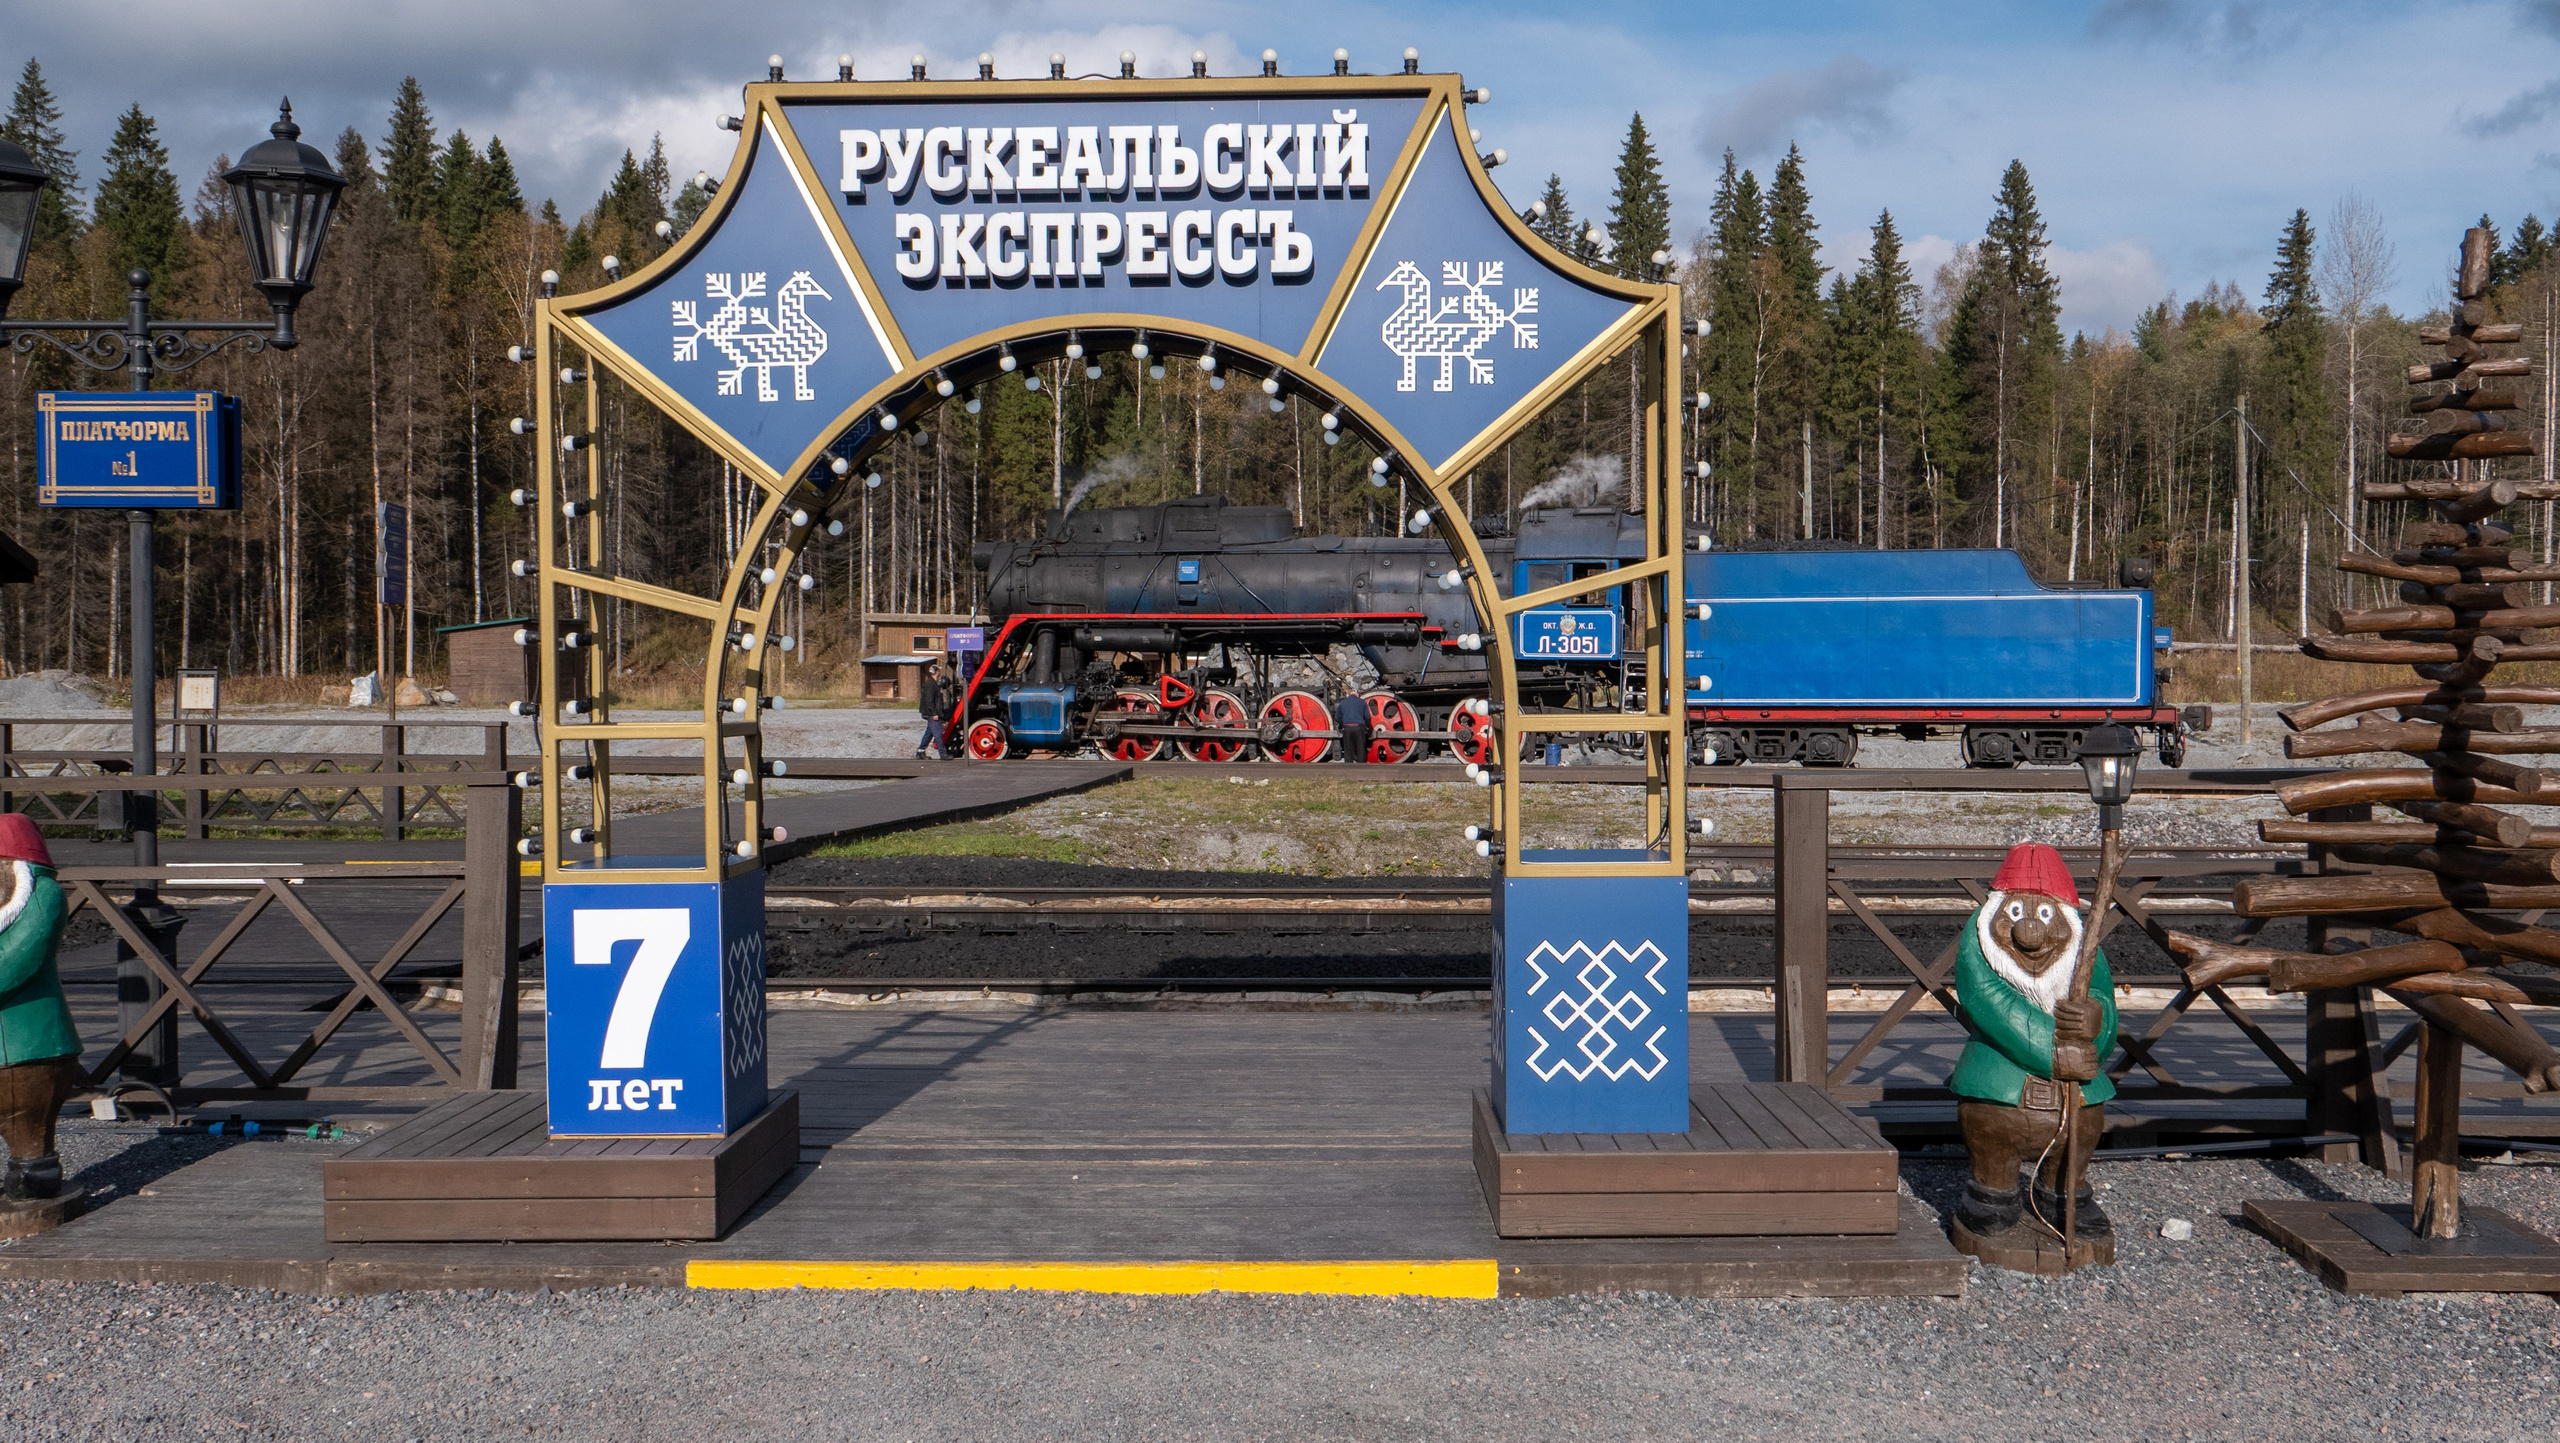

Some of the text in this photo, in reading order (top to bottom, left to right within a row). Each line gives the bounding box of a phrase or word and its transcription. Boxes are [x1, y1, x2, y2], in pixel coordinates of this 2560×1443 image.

[895, 208, 1314, 286] ЭКСПРЕССЪ
[60, 420, 190, 442] ПЛАТФОРМА
[111, 450, 139, 477] №1
[1542, 621, 1597, 631] ОКТ. Ж.Д.
[1537, 635, 1599, 654] Л-3051
[572, 907, 691, 1069] 7
[587, 1078, 684, 1111] лет
